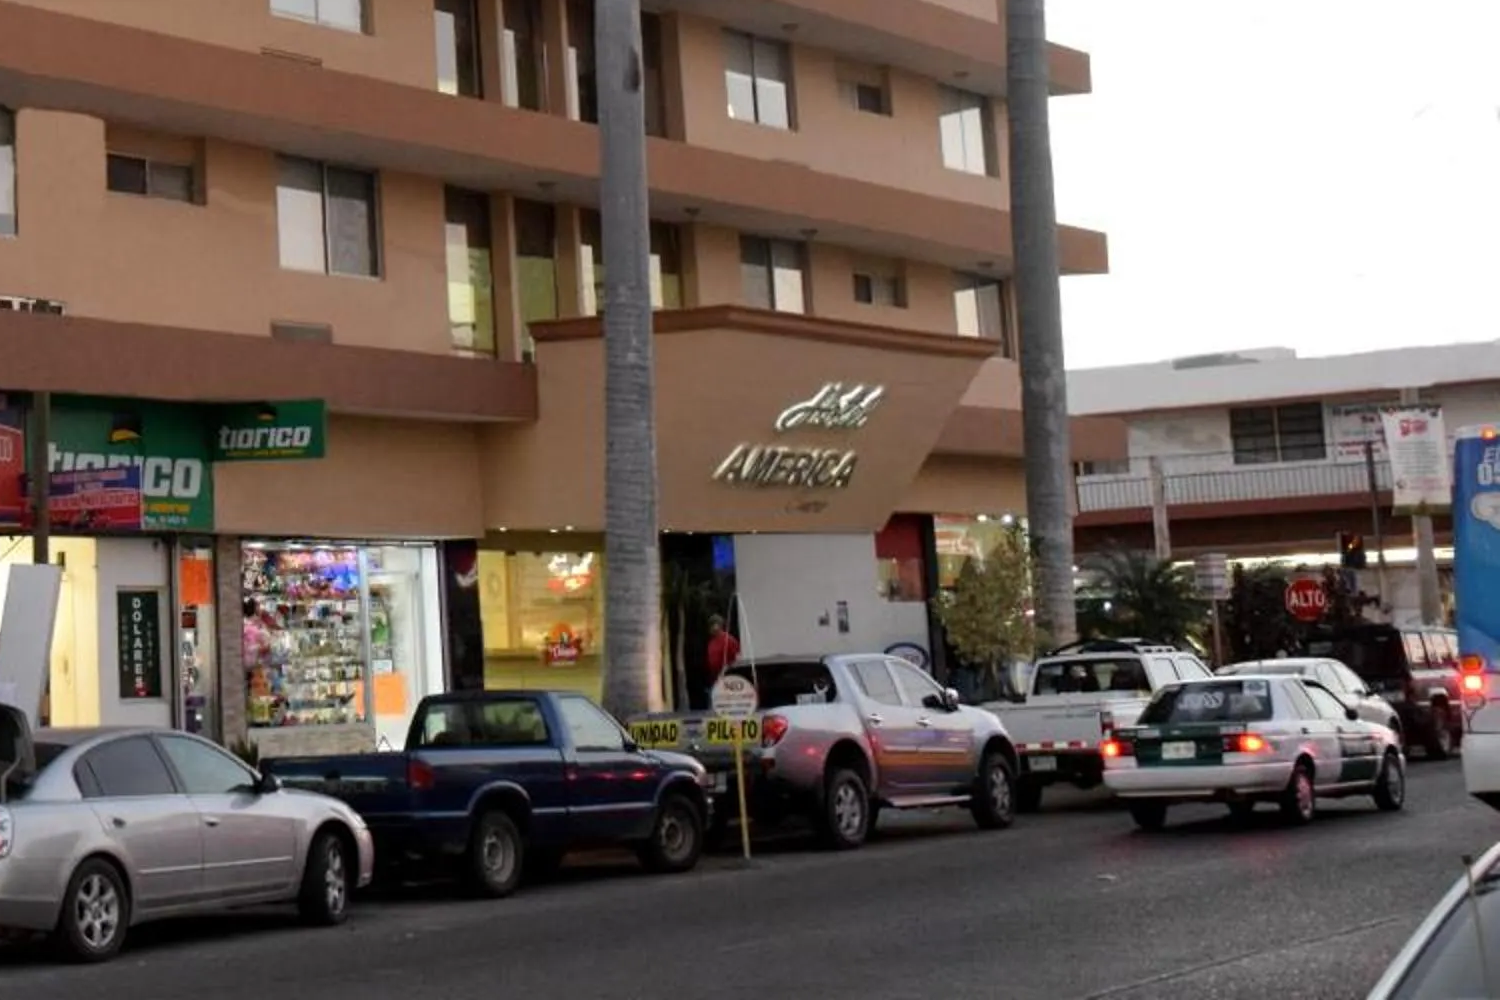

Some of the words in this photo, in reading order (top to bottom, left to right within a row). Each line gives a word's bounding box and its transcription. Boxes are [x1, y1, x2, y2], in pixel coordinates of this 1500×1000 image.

[712, 444, 858, 488] AMERICA
[1289, 590, 1326, 608] ALTO
[131, 597, 144, 689] DOLARES
